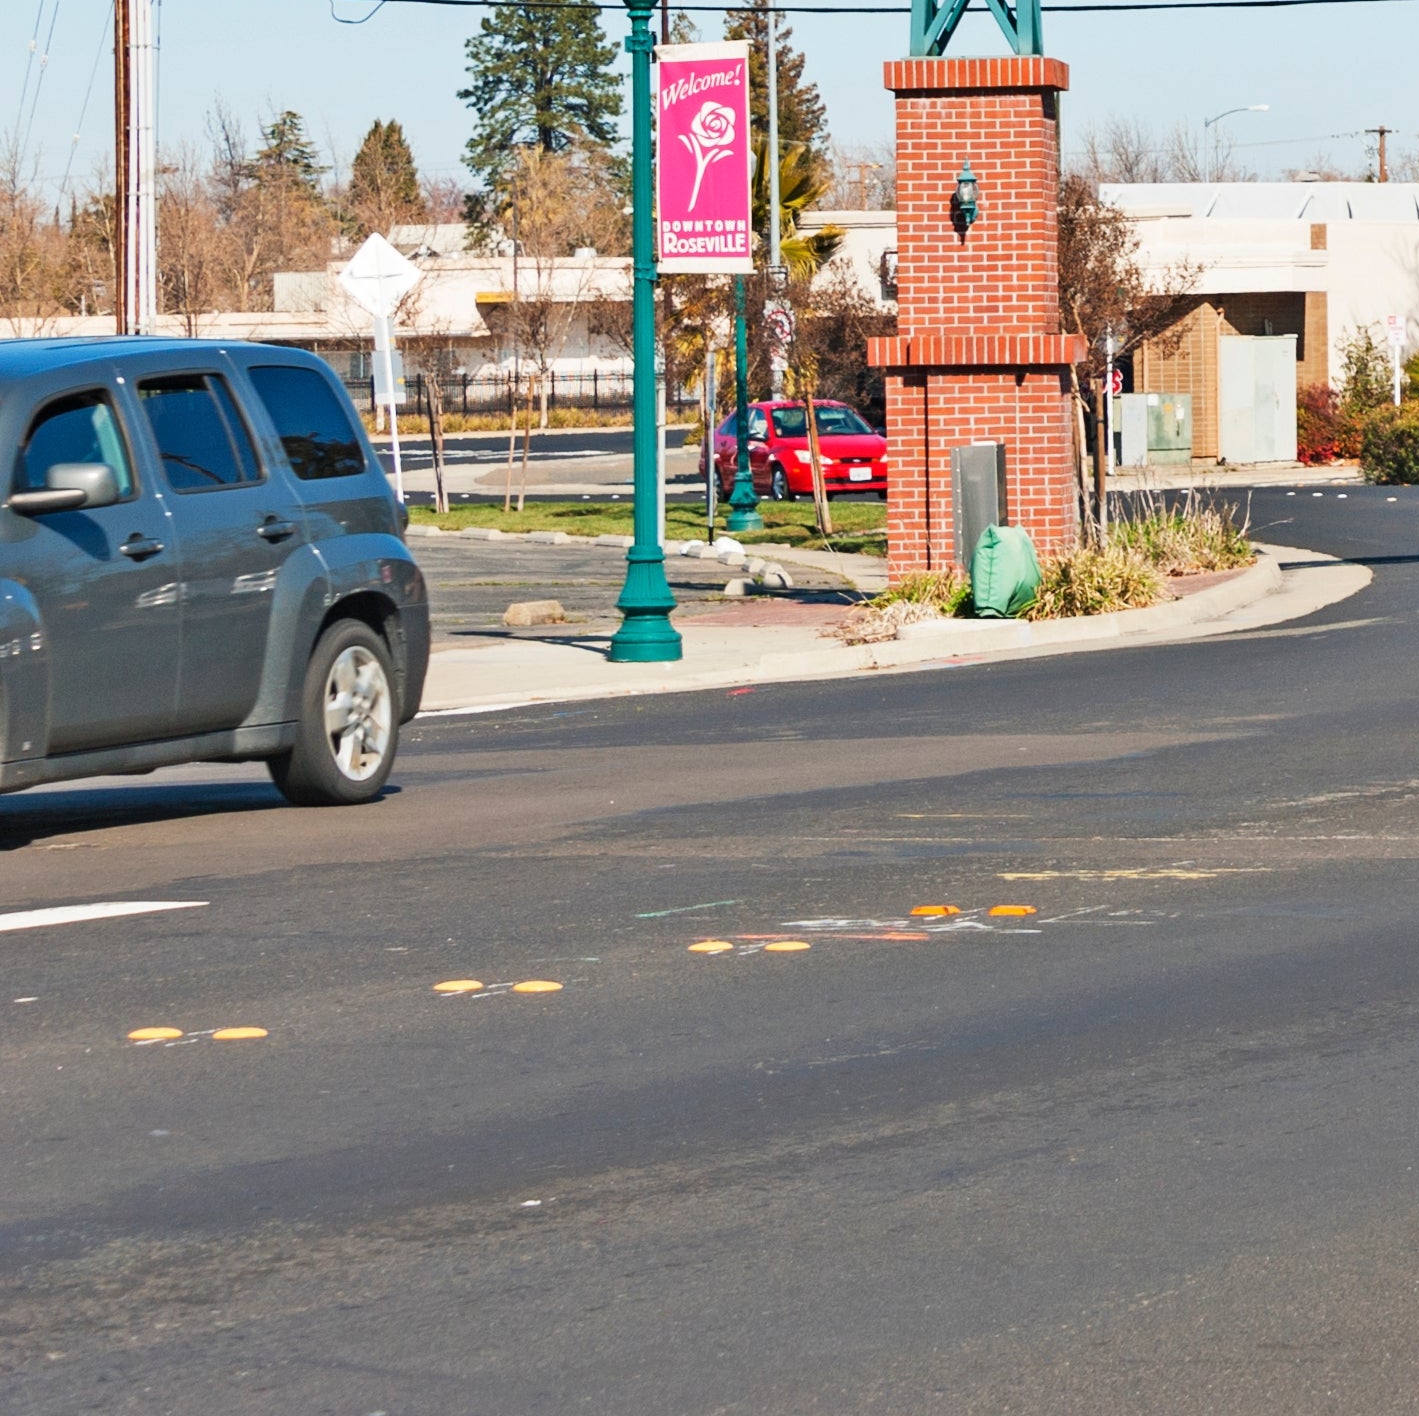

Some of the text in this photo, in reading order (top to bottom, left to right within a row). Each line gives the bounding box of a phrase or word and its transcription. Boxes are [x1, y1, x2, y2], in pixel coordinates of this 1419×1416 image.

[661, 64, 742, 110] Welcome!
[662, 220, 746, 232] DOWNTOWN
[663, 232, 746, 254] ROSEVILLE
